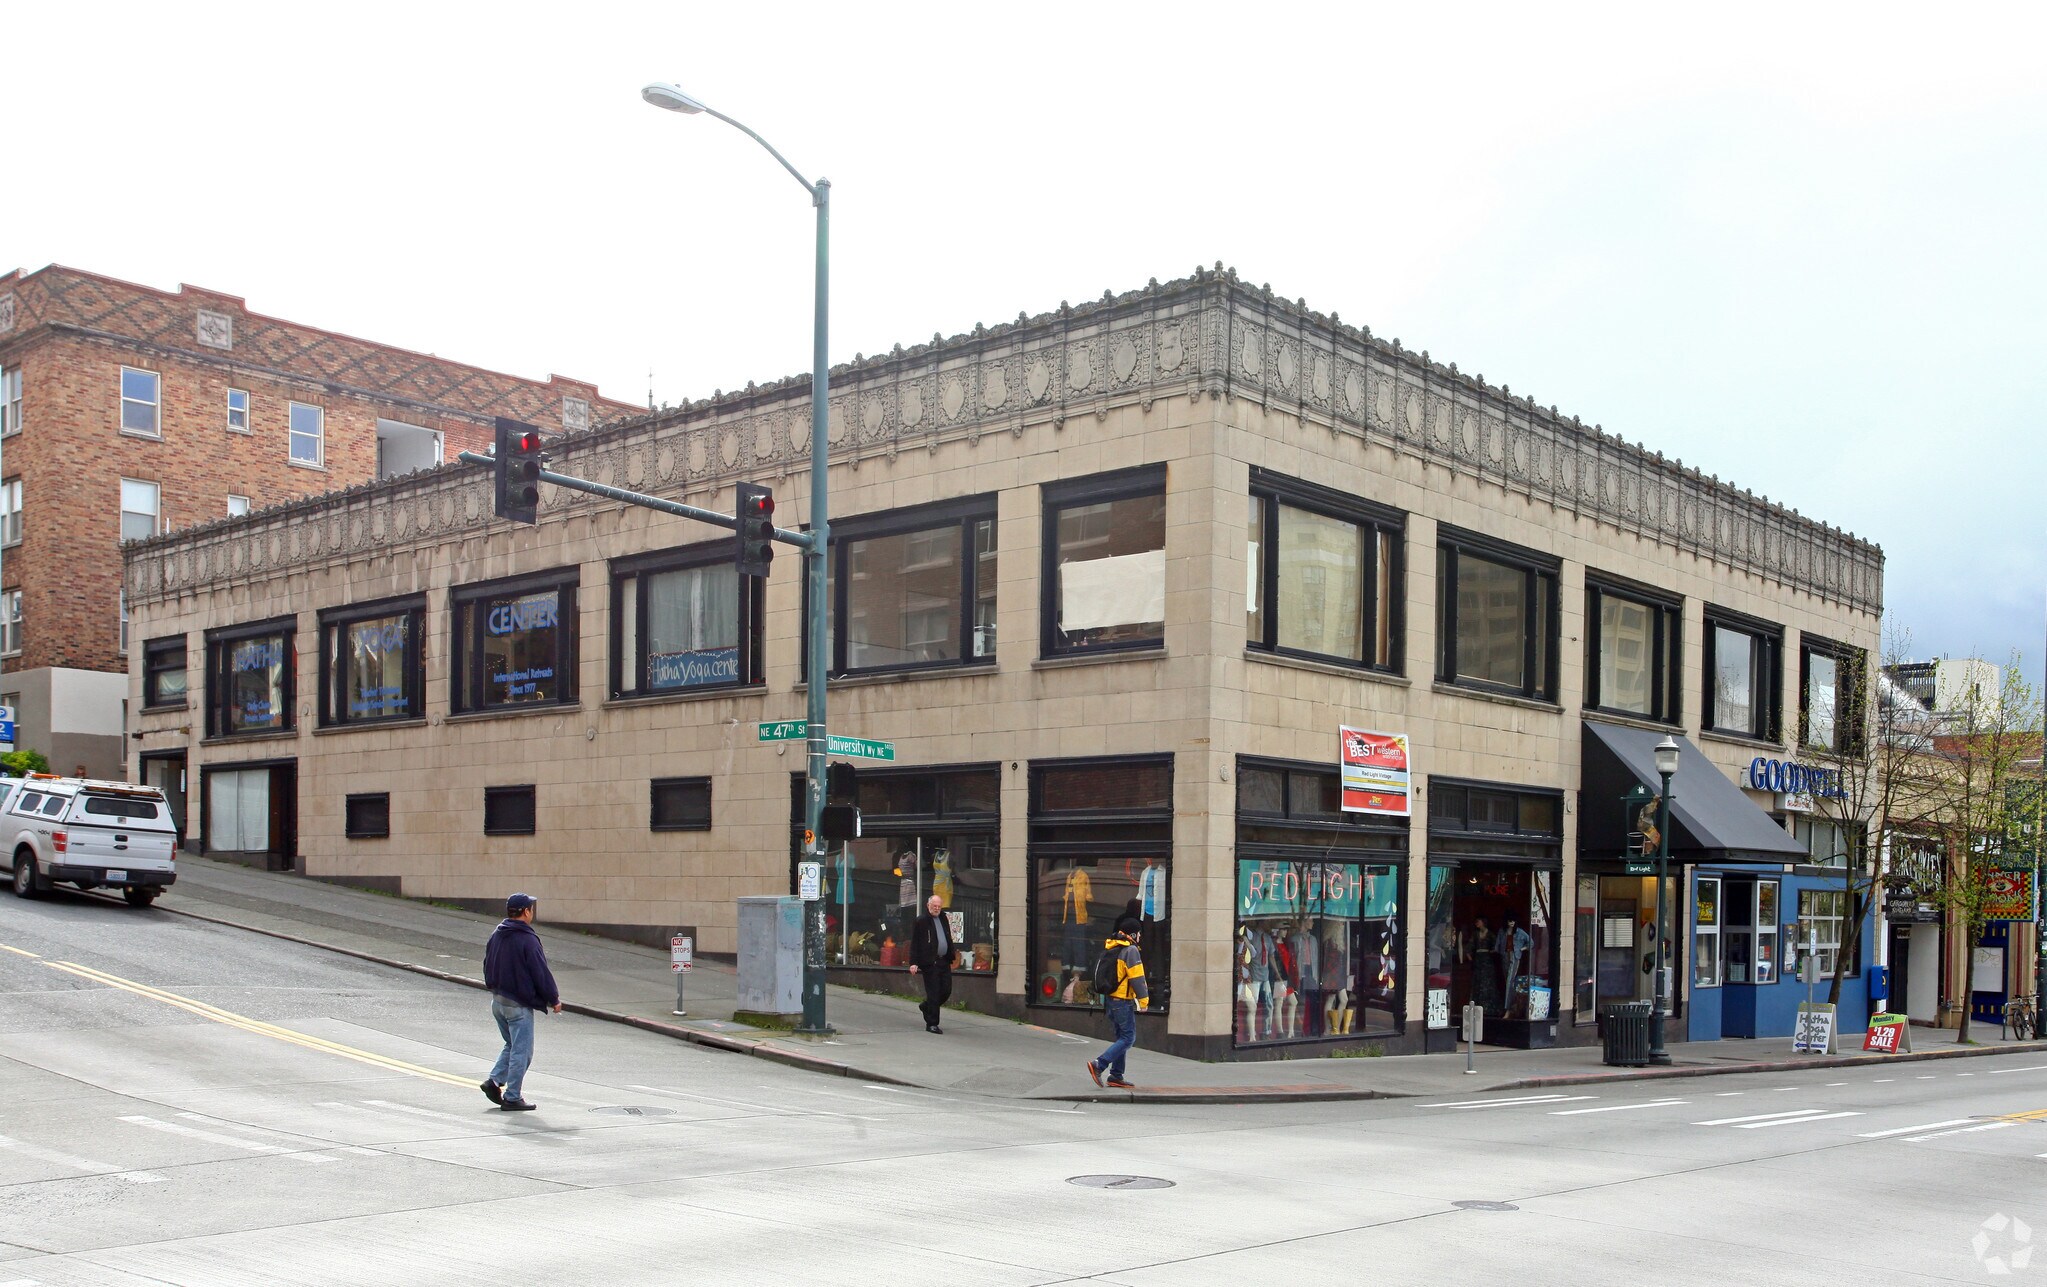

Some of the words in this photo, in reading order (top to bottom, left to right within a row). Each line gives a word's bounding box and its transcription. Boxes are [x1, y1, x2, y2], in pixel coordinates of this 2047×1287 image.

[488, 600, 558, 634] CENTER
[357, 624, 404, 657] YOGA
[235, 642, 283, 672] HATHA
[494, 668, 530, 683] International
[531, 667, 553, 679] Retreats
[653, 658, 680, 684] Hatha
[509, 684, 523, 695] Since
[760, 728, 770, 737] NE
[774, 724, 794, 737] 47th
[798, 725, 805, 734] St
[828, 736, 866, 756] University
[867, 745, 875, 757] Wy
[877, 747, 884, 756] NE
[1346, 738, 1357, 748] the
[1350, 743, 1376, 758] BEST
[1379, 772, 1392, 780] Vintage
[1250, 872, 1298, 900] RED
[1307, 872, 1376, 900] LIGHT
[1873, 1015, 1894, 1023] Monday
[1873, 1026, 1895, 1037] $1.29
[1870, 1036, 1894, 1048] SALE
